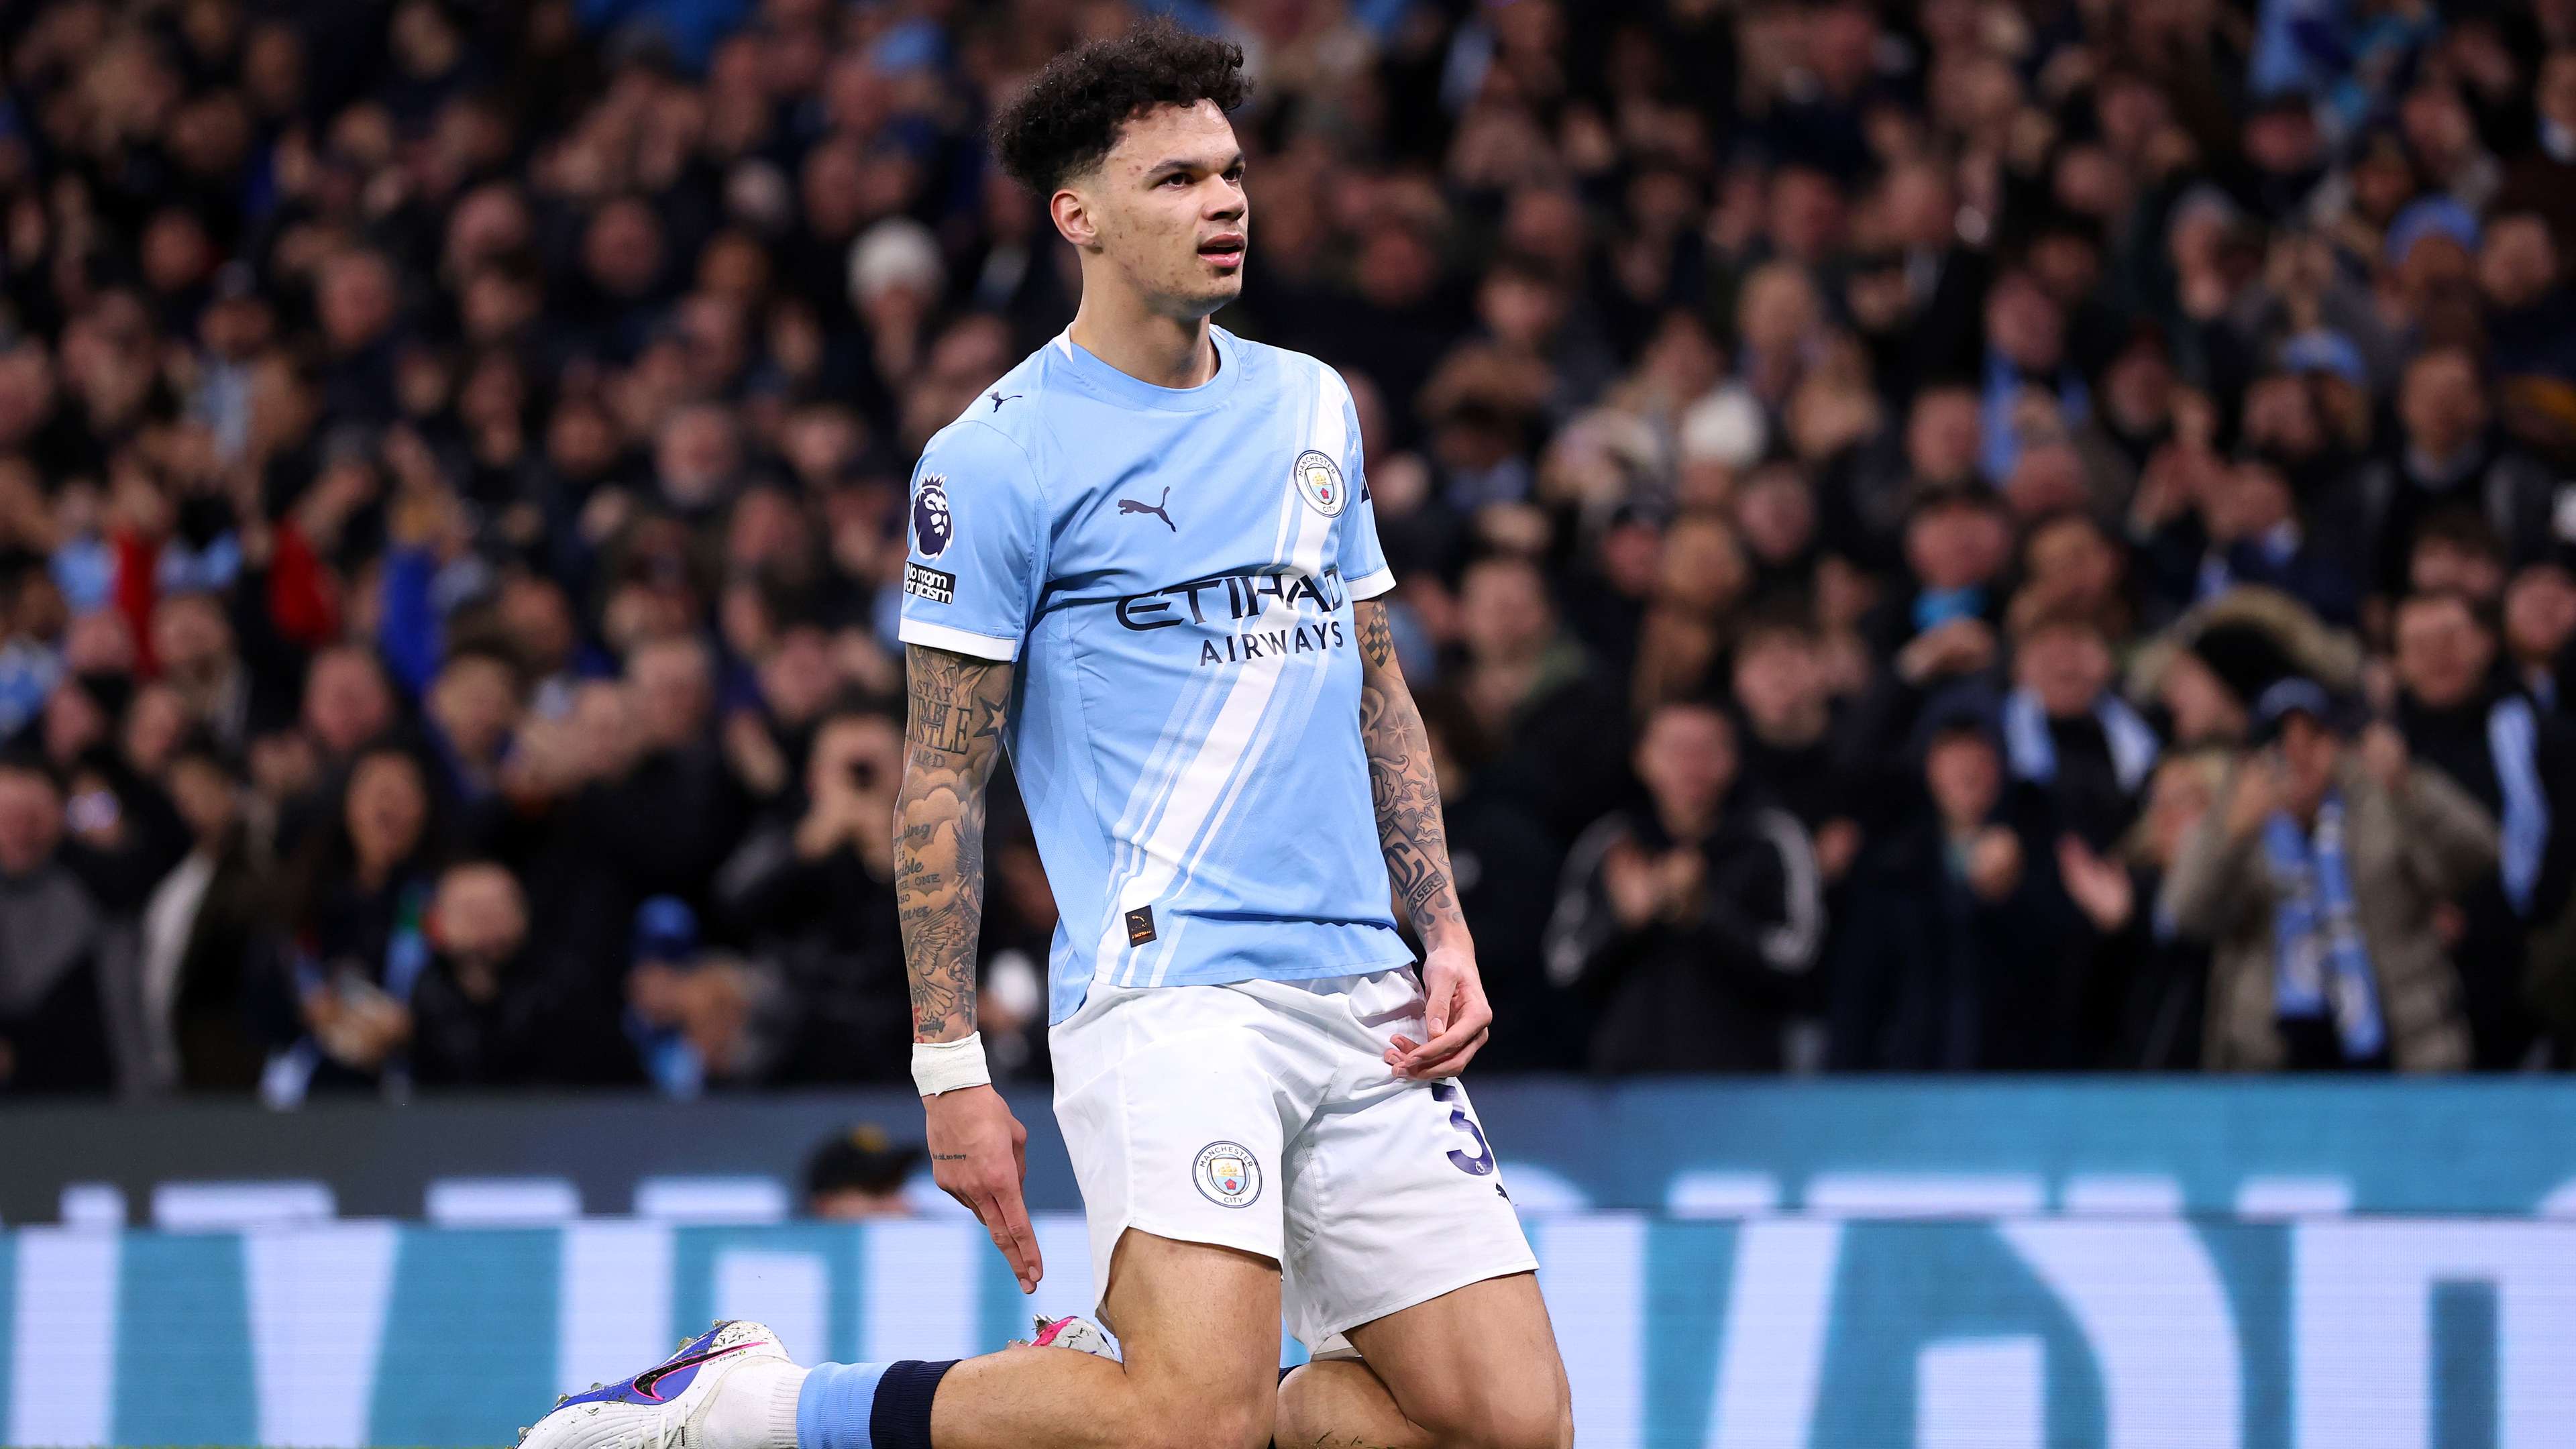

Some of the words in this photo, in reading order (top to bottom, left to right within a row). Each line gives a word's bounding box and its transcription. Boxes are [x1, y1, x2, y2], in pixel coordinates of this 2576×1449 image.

[1299, 455, 1336, 477] MANCHESTER
[906, 562, 917, 580] No
[918, 569, 948, 589] room
[1116, 569, 1343, 631] ETIHAD
[1200, 621, 1344, 667] AIRWAYS
[916, 680, 954, 702] STAY
[915, 873, 941, 886] ONE
[1199, 1146, 1253, 1168] MANCHESTER
